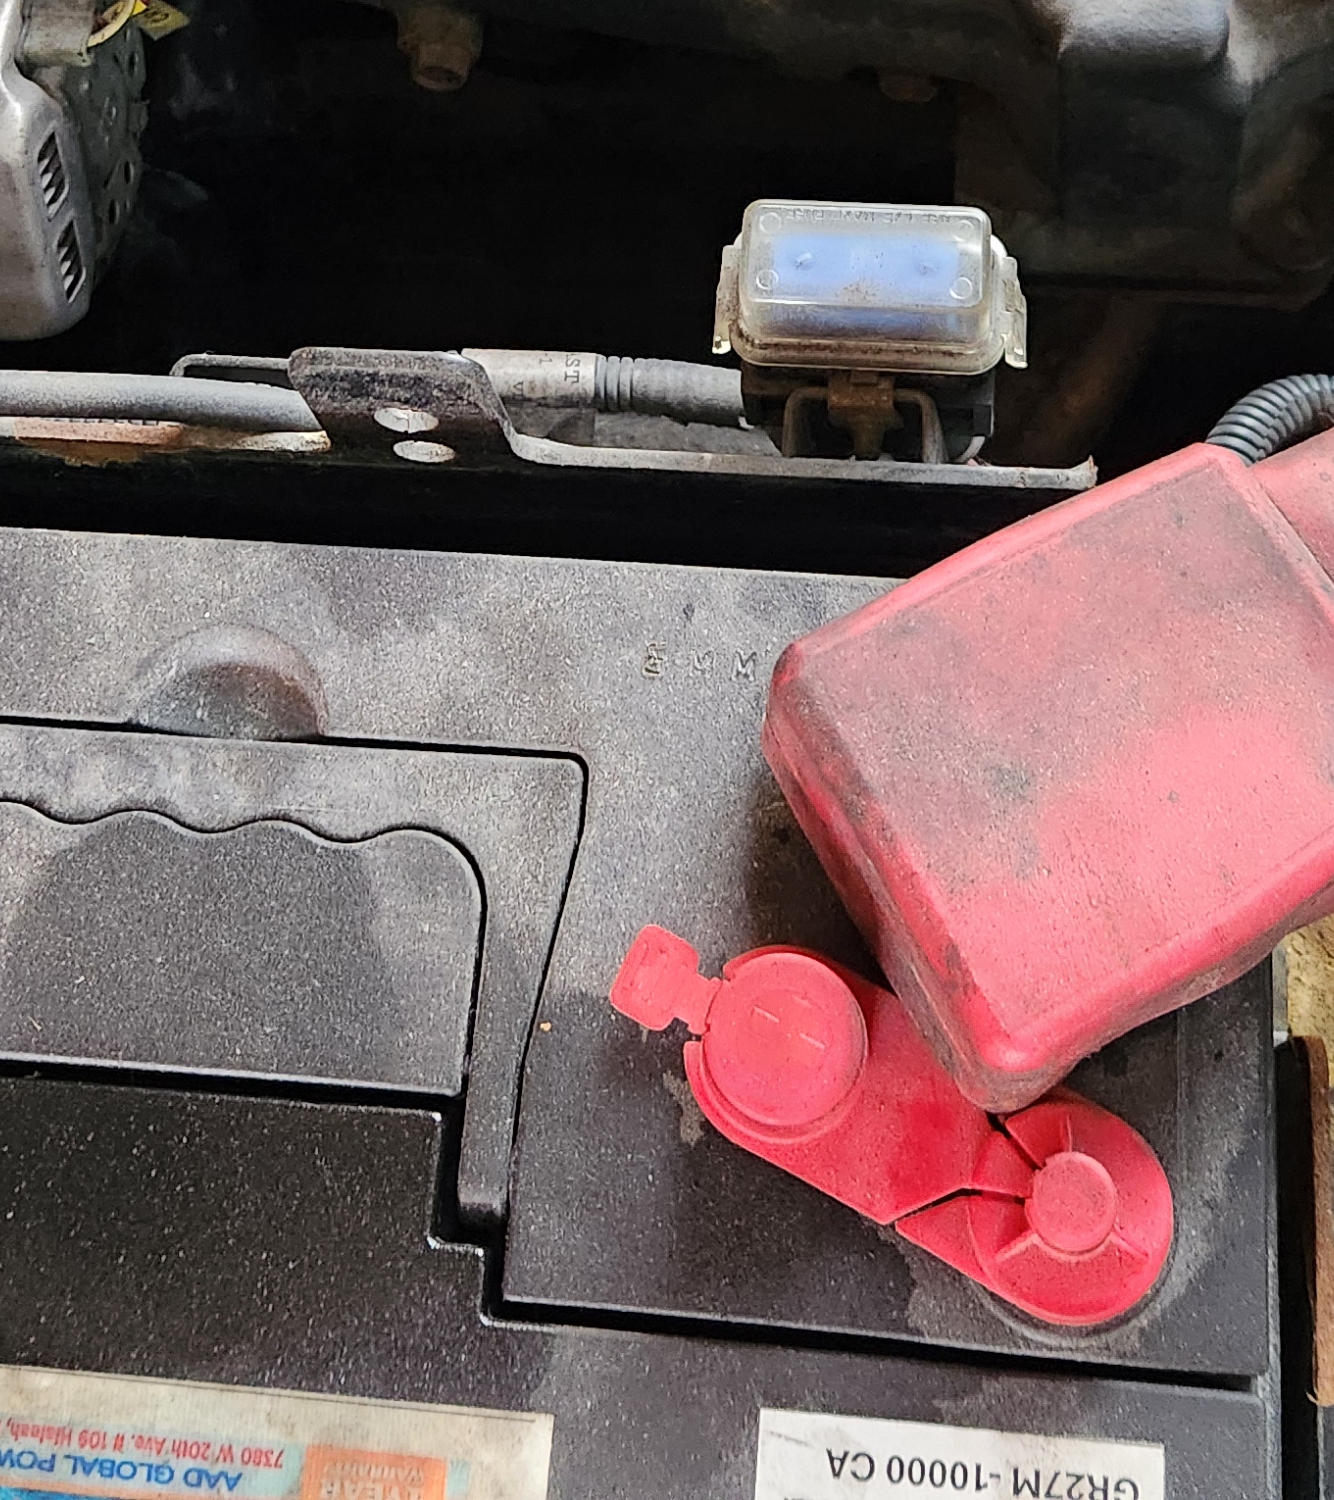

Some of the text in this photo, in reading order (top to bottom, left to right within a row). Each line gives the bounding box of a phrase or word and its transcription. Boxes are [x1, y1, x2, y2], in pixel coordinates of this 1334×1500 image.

[216, 1444, 234, 1462] W
[826, 1448, 876, 1482] CA
[64, 1454, 175, 1485] GLOBAL
[183, 1467, 243, 1492] AAD
